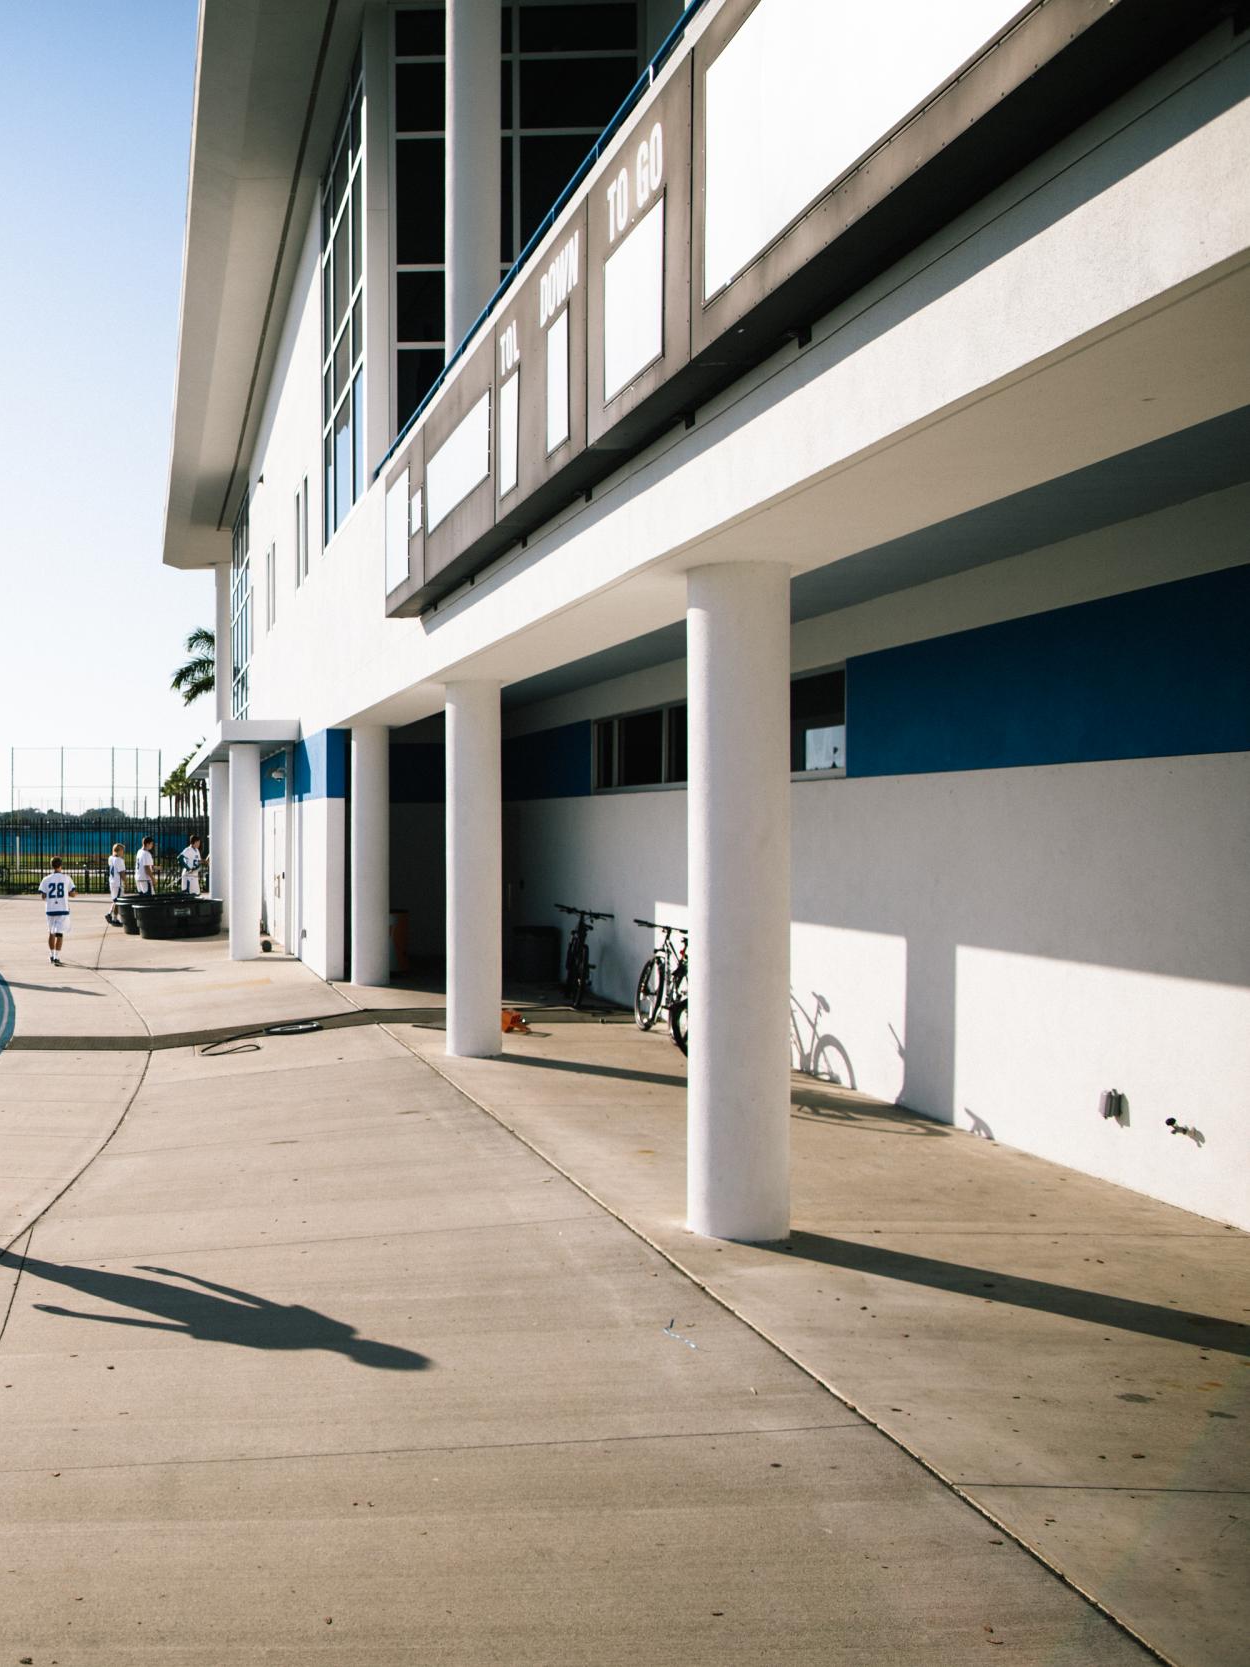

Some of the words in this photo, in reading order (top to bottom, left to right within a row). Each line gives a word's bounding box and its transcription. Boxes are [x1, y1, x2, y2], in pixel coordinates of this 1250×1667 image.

[607, 167, 628, 243] TO
[636, 121, 663, 209] GO
[539, 229, 579, 328] DOWN
[500, 320, 520, 376] TOL
[48, 882, 65, 899] 28
